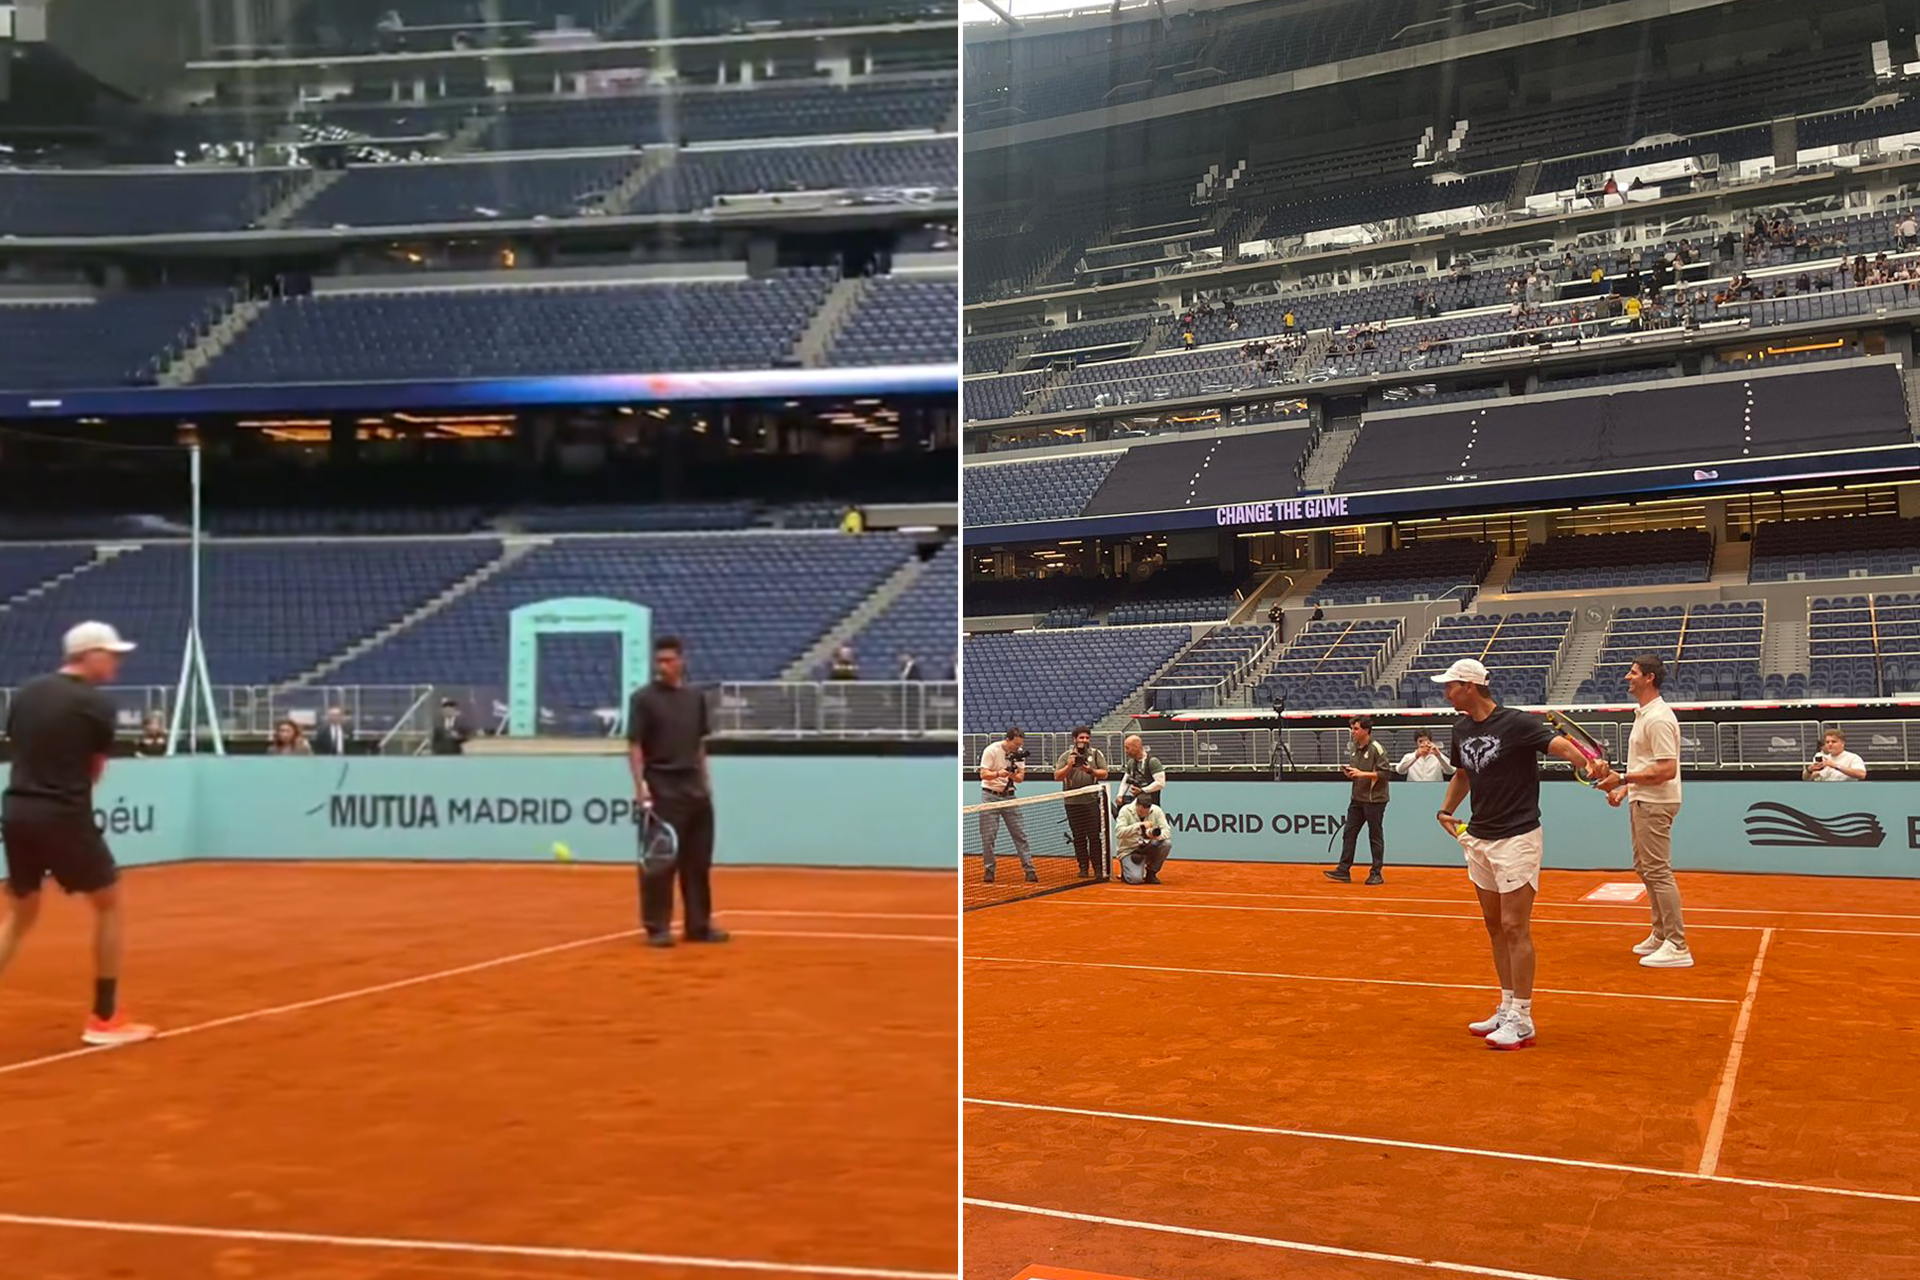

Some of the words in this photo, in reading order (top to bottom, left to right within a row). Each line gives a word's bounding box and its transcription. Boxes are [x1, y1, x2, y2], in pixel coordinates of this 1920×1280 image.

[1216, 502, 1273, 526] CHANGE
[1275, 500, 1303, 520] THE
[1304, 496, 1349, 519] GAME
[330, 794, 438, 828] MUTUA
[448, 797, 572, 824] MADRID
[583, 797, 642, 825] OPE
[1165, 812, 1263, 834] MADRID
[1271, 813, 1346, 835] OPEN
